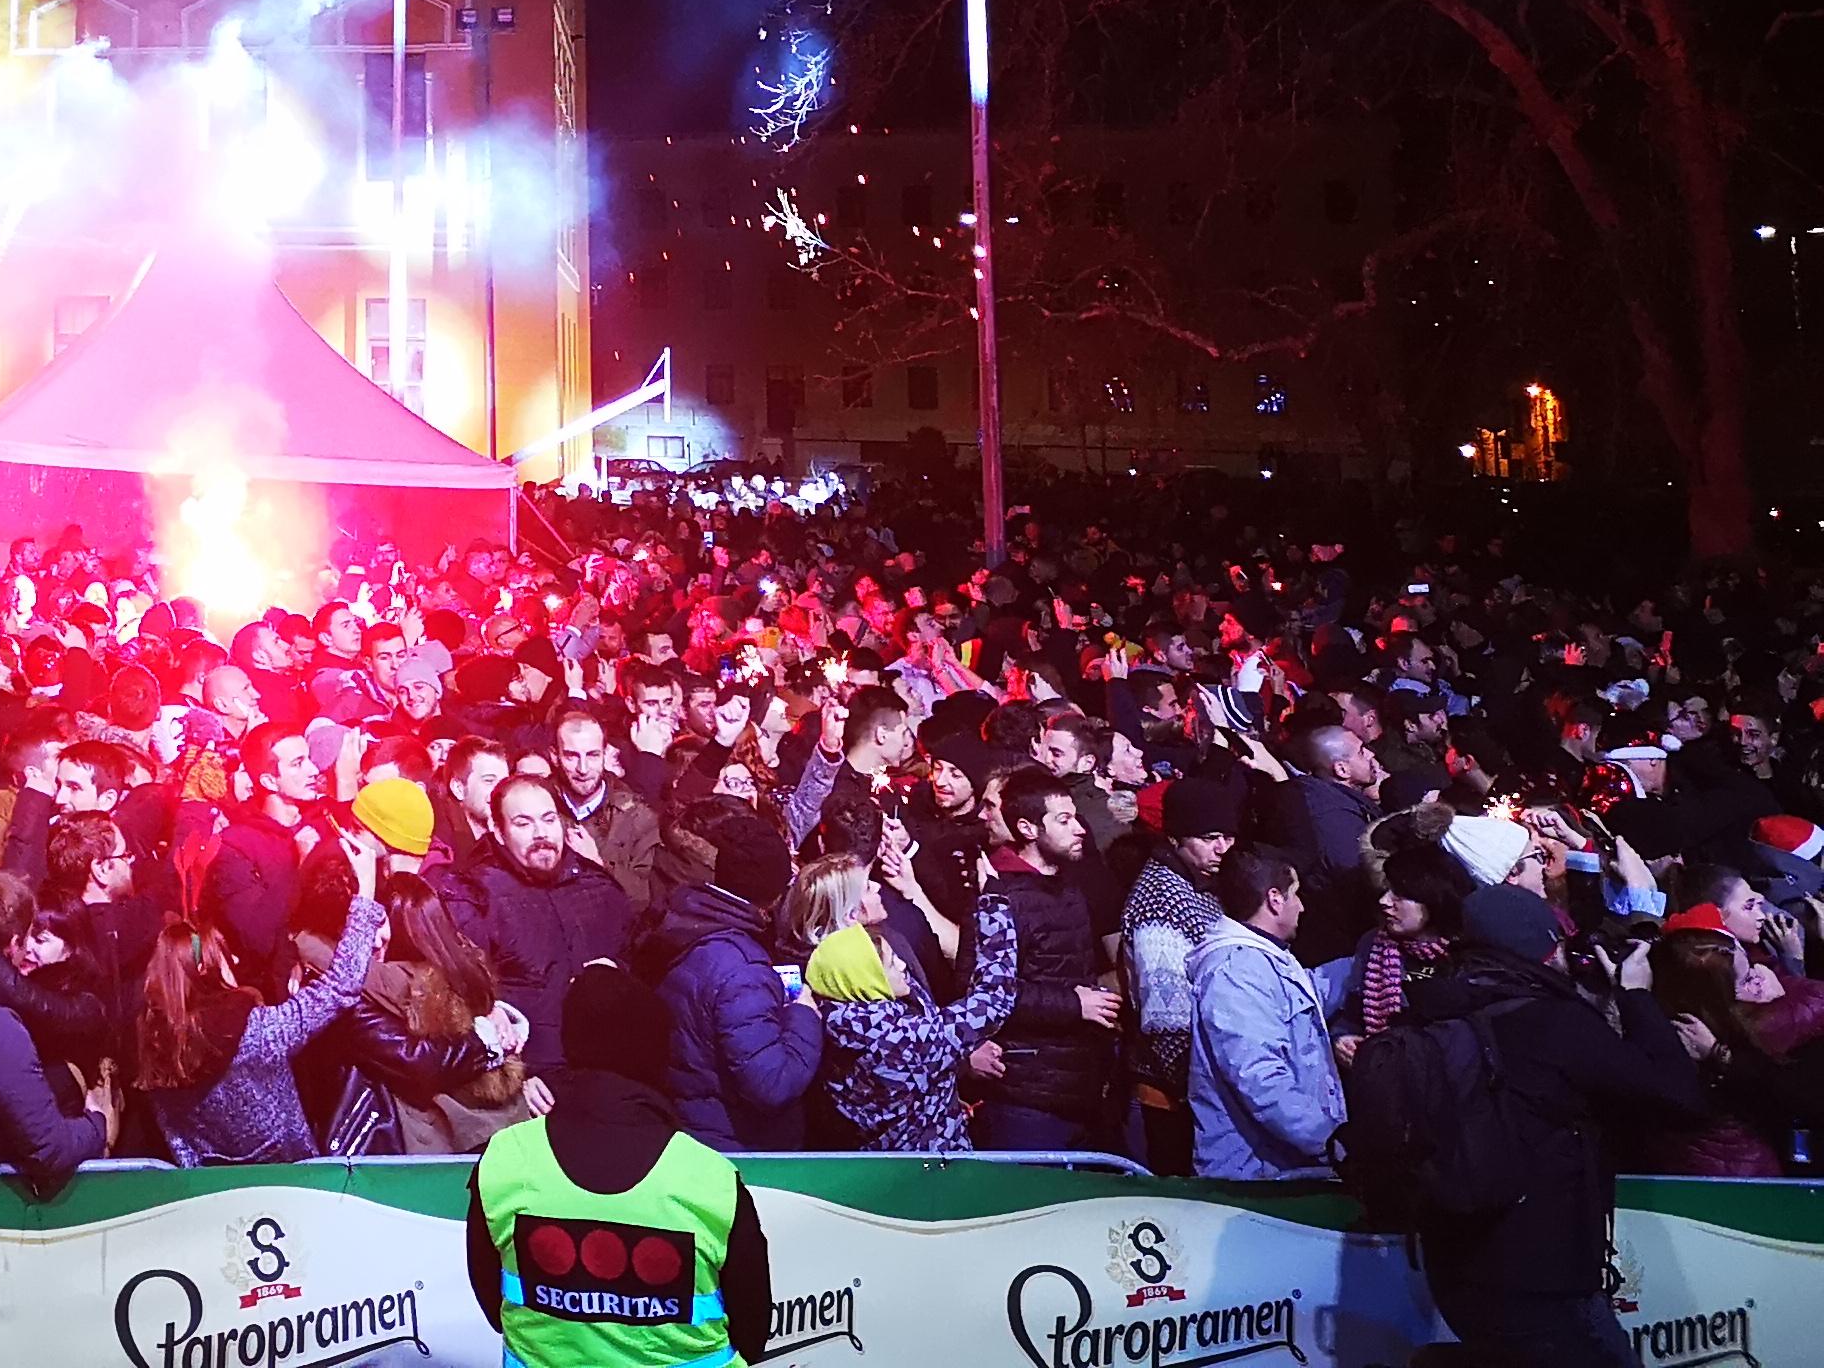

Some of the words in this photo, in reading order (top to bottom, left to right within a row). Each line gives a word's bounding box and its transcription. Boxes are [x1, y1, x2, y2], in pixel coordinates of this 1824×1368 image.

[246, 1217, 290, 1282] S
[1127, 1221, 1172, 1284] S
[257, 1285, 283, 1297] 1869
[535, 1284, 680, 1318] SECURITAS
[1142, 1286, 1168, 1298] 1869
